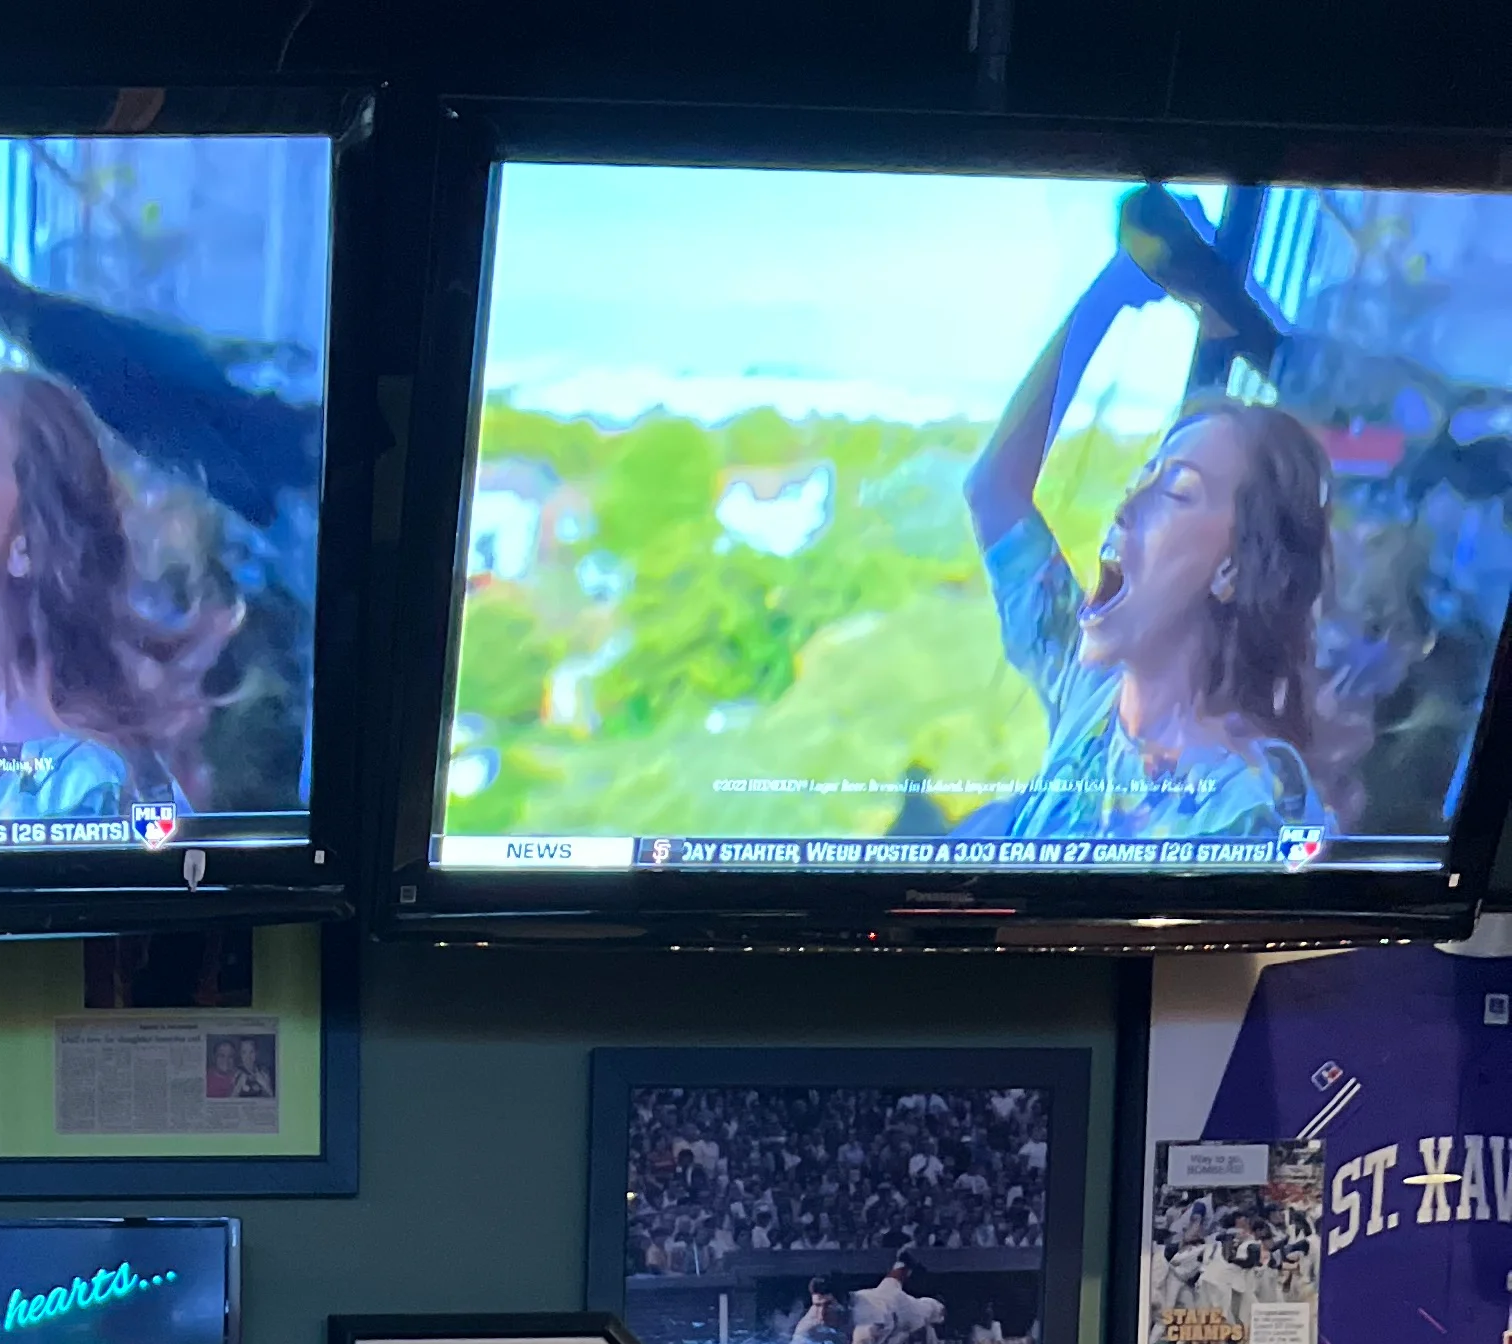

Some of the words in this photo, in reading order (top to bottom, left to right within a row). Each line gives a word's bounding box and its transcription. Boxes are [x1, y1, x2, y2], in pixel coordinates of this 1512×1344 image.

[12, 824, 44, 845] (26
[49, 822, 129, 843] STARTS)
[506, 842, 572, 859] NEWS
[864, 842, 934, 862] POSTED
[934, 844, 949, 862] A
[953, 843, 995, 863] 3.03
[999, 843, 1036, 862] ERA
[1039, 843, 1059, 862] IN
[1063, 843, 1090, 862] 27
[1092, 843, 1155, 862] GAMES
[1327, 1143, 1400, 1256] ST.
[3, 1260, 178, 1332] hearts...
[1161, 1307, 1223, 1326] STATE
